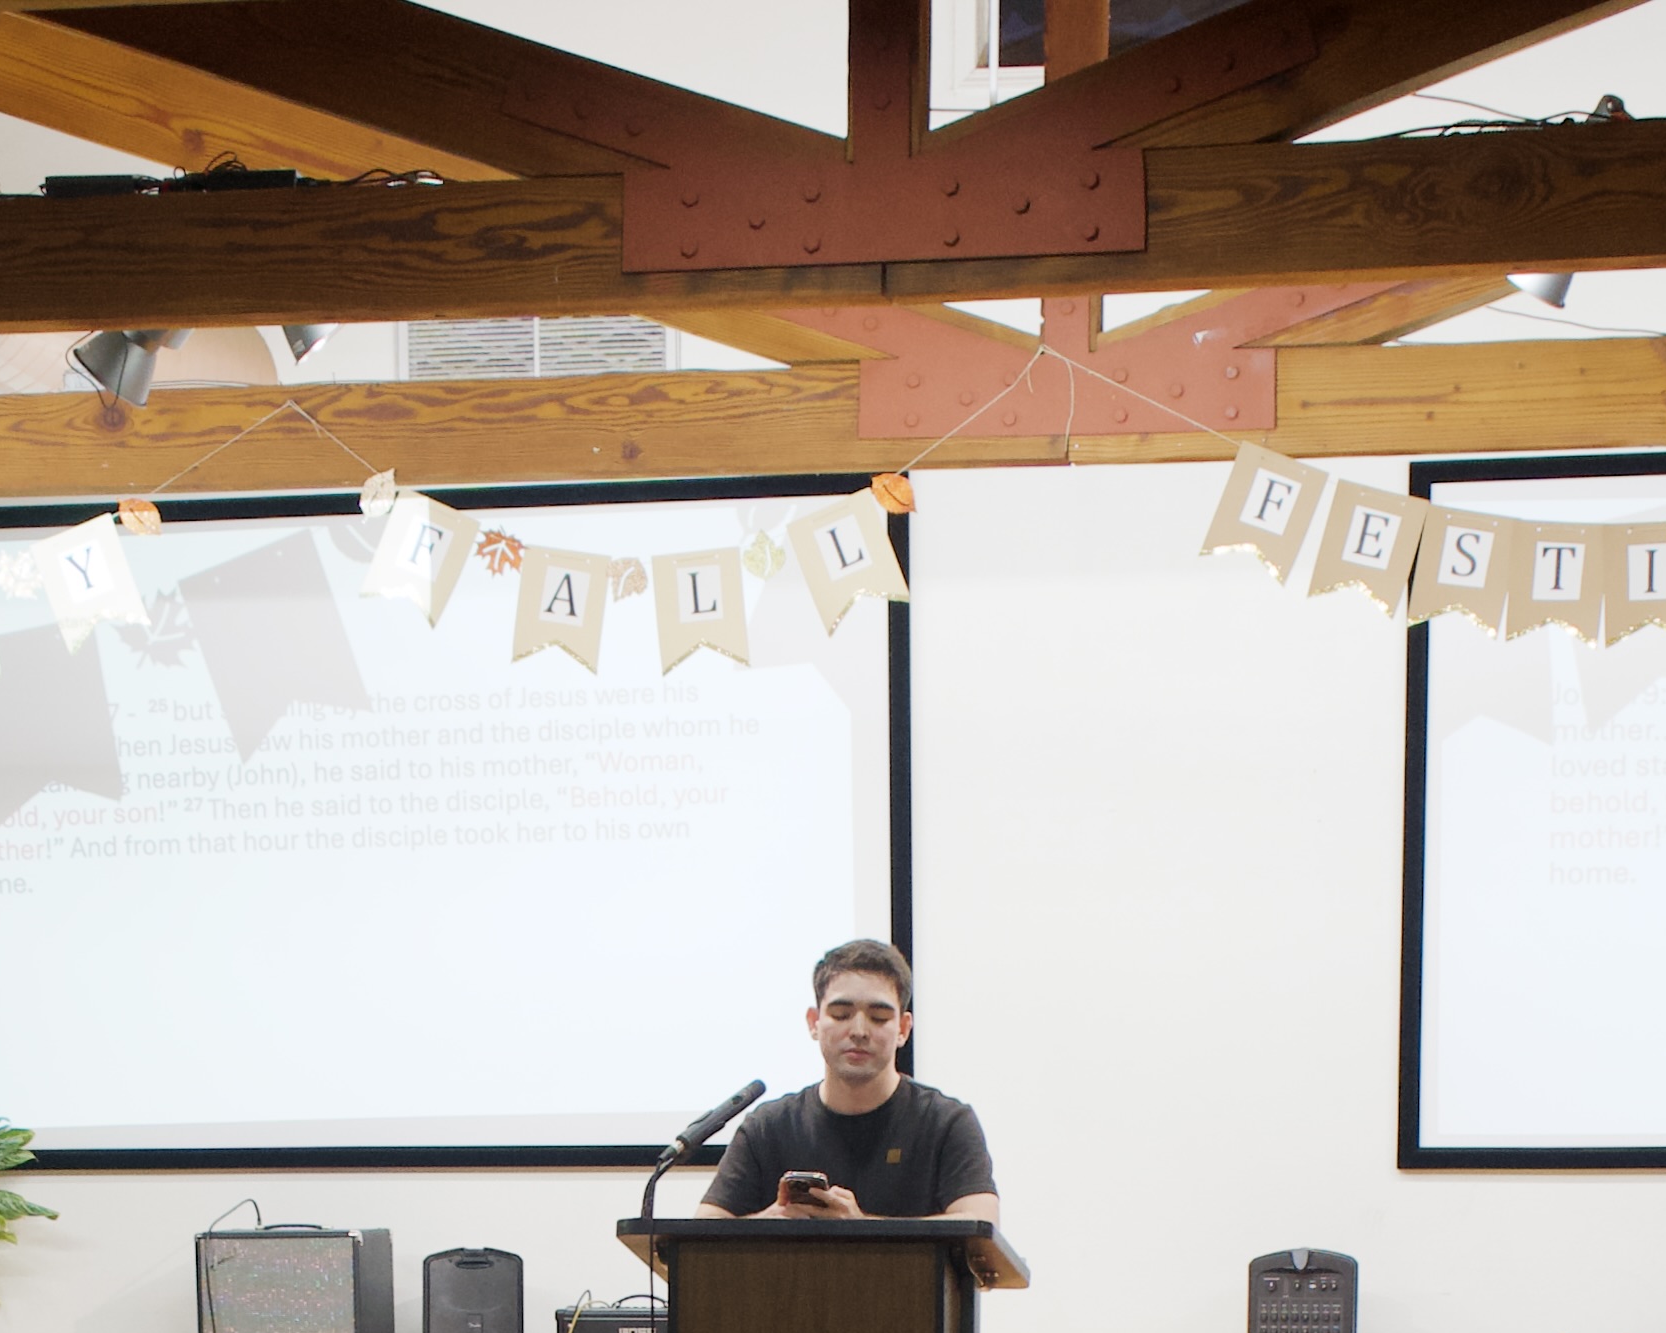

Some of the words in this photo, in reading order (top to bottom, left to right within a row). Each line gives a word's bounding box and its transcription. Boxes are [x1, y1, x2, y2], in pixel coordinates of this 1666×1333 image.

[173, 701, 212, 722] but
[413, 690, 481, 712] cross
[488, 688, 513, 710] of
[518, 685, 587, 709] Jesus
[594, 684, 655, 706] were
[663, 680, 699, 704] his
[117, 736, 162, 758] hen
[169, 734, 235, 756] Jesus
[260, 734, 292, 752] aw
[299, 729, 334, 751] his
[341, 724, 430, 749] mother
[438, 722, 483, 746] and
[491, 720, 530, 743] the
[538, 717, 636, 746] disciple
[643, 715, 721, 738] whom
[729, 713, 760, 736] he
[137, 766, 218, 792] nearby
[226, 764, 306, 788] (John),
[314, 760, 343, 784] he
[350, 757, 401, 781] said
[408, 760, 432, 780] to
[440, 756, 475, 779] his
[483, 754, 578, 778] mother,
[1551, 754, 1626, 778] loved
[53, 805, 107, 830] your
[208, 798, 267, 821] Then
[275, 796, 304, 819] he
[311, 793, 361, 817] said
[368, 795, 393, 815] to
[400, 791, 439, 814] the
[447, 788, 551, 816] disciple,
[673, 784, 729, 811] your
[1550, 789, 1657, 816] behold,
[70, 837, 117, 859] And
[124, 834, 180, 856] from
[188, 832, 235, 854] that
[243, 830, 299, 852] hour
[307, 828, 345, 850] the
[352, 824, 448, 852] disciple
[454, 821, 509, 846] took
[516, 821, 556, 844] her
[563, 820, 588, 842] to
[596, 818, 631, 841] his
[638, 821, 690, 840] own
[1550, 861, 1637, 886] home.
